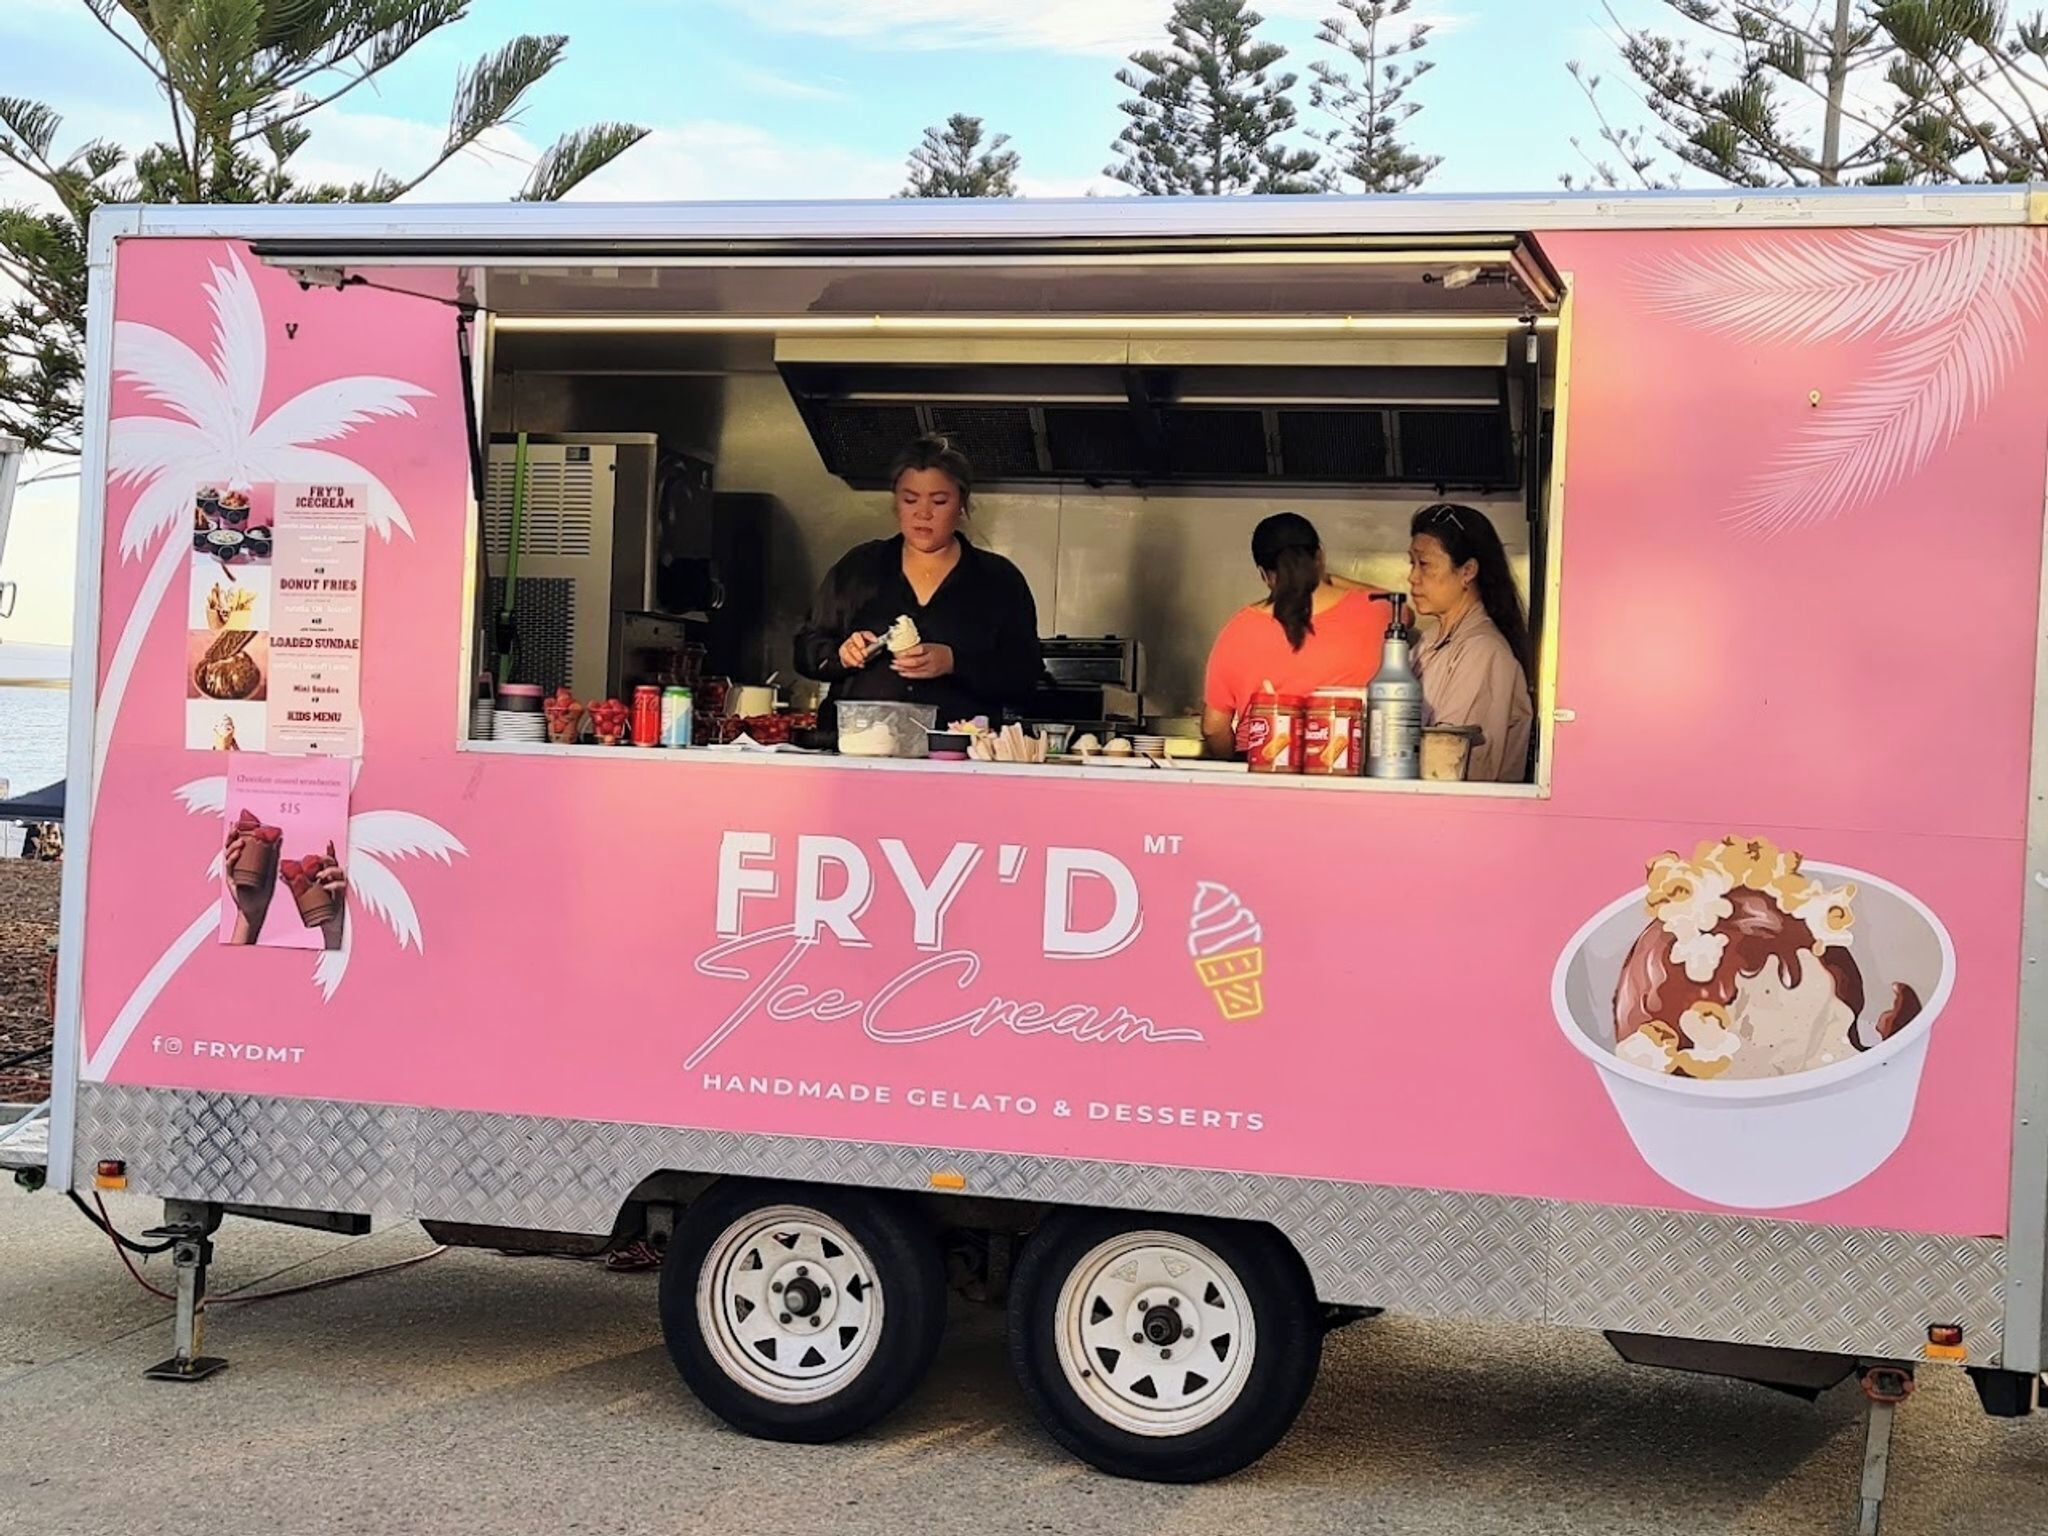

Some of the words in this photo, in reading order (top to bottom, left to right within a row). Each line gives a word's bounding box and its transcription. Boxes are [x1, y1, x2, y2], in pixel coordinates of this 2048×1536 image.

[310, 486, 344, 497] FRY'D
[296, 497, 354, 509] ICECREAM
[280, 578, 319, 590] DONUT
[323, 579, 357, 591] FRIES
[270, 636, 313, 648] LOADED
[315, 638, 359, 650] SUNDAE
[287, 711, 311, 721] KIDS
[313, 712, 342, 722] MENU
[280, 802, 301, 815] $15
[714, 830, 1144, 962] FRY'D
[1144, 834, 1183, 855] MT
[684, 921, 864, 1071] Ice
[863, 950, 1204, 1046] Cream
[193, 1040, 305, 1063] FRYDMT
[703, 1073, 892, 1104] HANDMADE
[907, 1088, 1037, 1115] GELATO
[1053, 1099, 1072, 1117] &
[1088, 1101, 1264, 1131] DESSERTS
